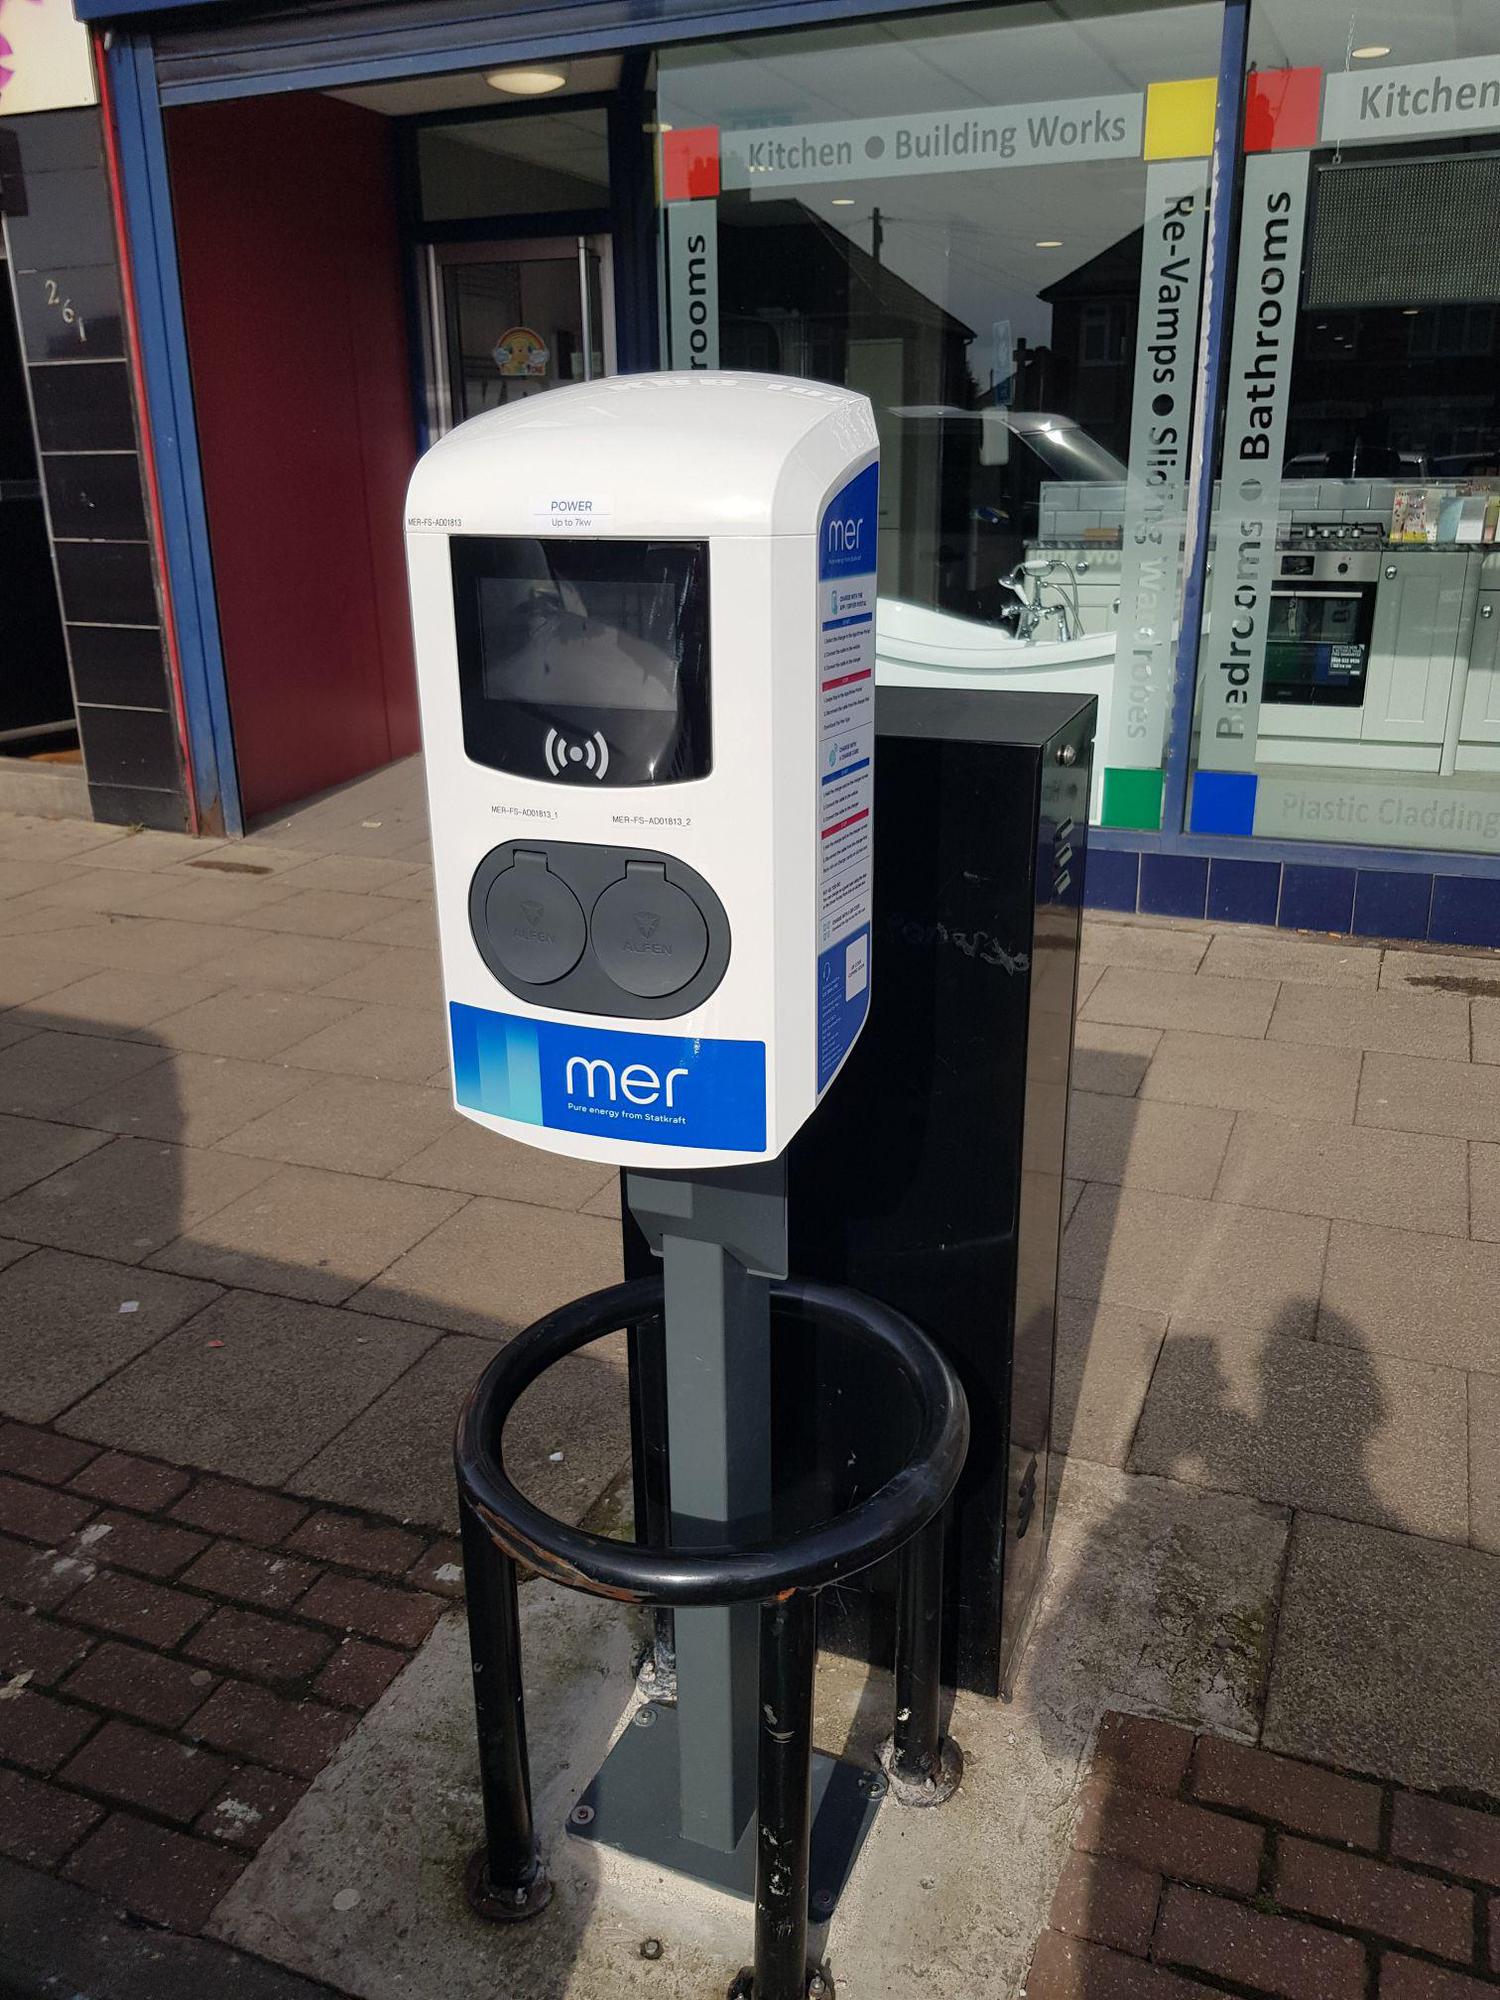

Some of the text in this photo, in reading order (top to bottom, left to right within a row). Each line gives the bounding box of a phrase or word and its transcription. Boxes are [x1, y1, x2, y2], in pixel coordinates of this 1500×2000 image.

[1360, 76, 1500, 120] Kitchen
[749, 110, 1126, 170] Kitchen Building Works
[1147, 195, 1195, 384] Re-Vamps
[1239, 191, 1291, 460] Bathrooms
[550, 501, 593, 512] POWER
[408, 517, 462, 527] MER-FS-AD01813
[551, 518, 561, 527] Up
[562, 518, 573, 527] to
[828, 518, 864, 552] mer
[612, 815, 692, 827] MER-FS-AD01813_2
[1281, 792, 1500, 840] Plastic Cladding
[513, 926, 556, 944] ALFEN
[624, 941, 673, 955] ALFEN
[566, 1056, 689, 1107] mer
[567, 1102, 687, 1125] Pure energy from Statkraft
